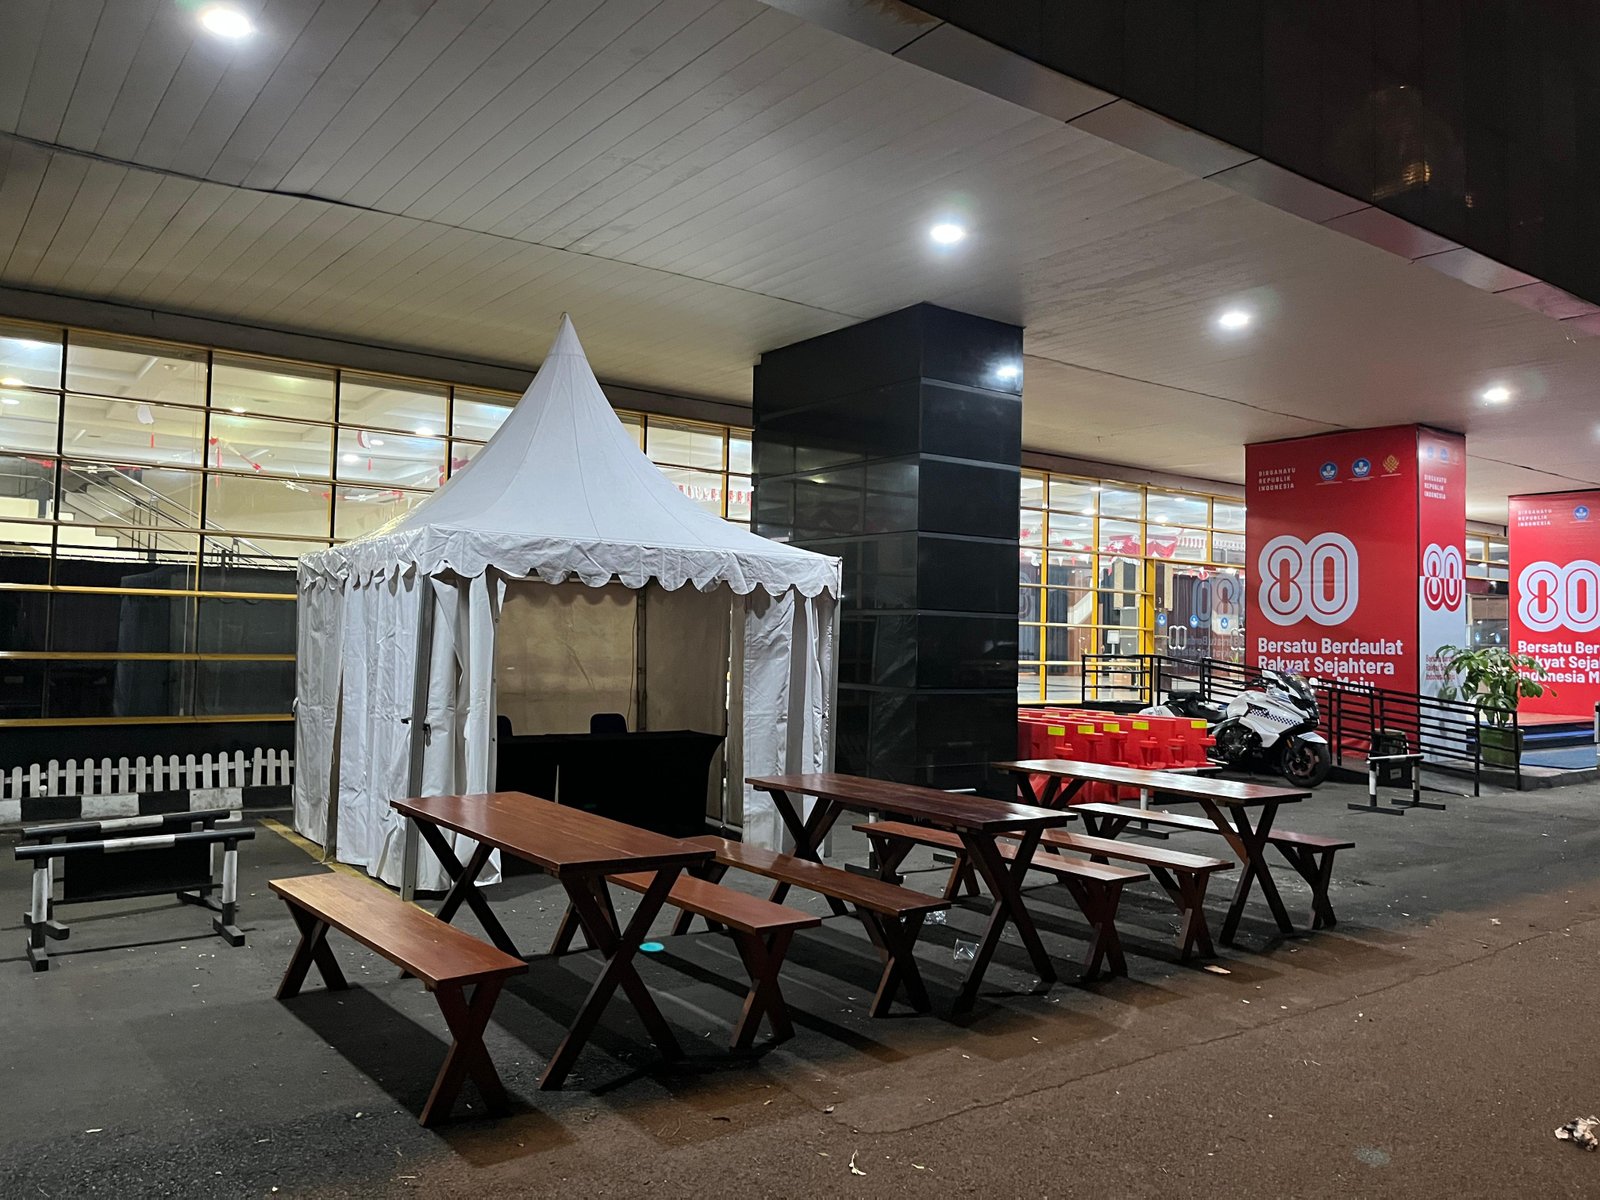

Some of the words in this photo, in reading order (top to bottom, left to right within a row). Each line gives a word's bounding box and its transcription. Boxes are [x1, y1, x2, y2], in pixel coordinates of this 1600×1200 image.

[1258, 475, 1291, 484] REPUBLIK
[1258, 483, 1295, 491] INDONESIA
[1258, 532, 1359, 626] 80
[1423, 543, 1463, 612] 80
[1517, 559, 1600, 633] 80
[1258, 637, 1317, 653] Bersatu
[1321, 638, 1404, 655] Berdaulat
[1517, 640, 1572, 654] Bersatu
[1258, 655, 1310, 672] Rakyat
[1313, 656, 1395, 677] Sejahtera
[1517, 655, 1566, 670] kyat
[1568, 655, 1600, 671] Seja
